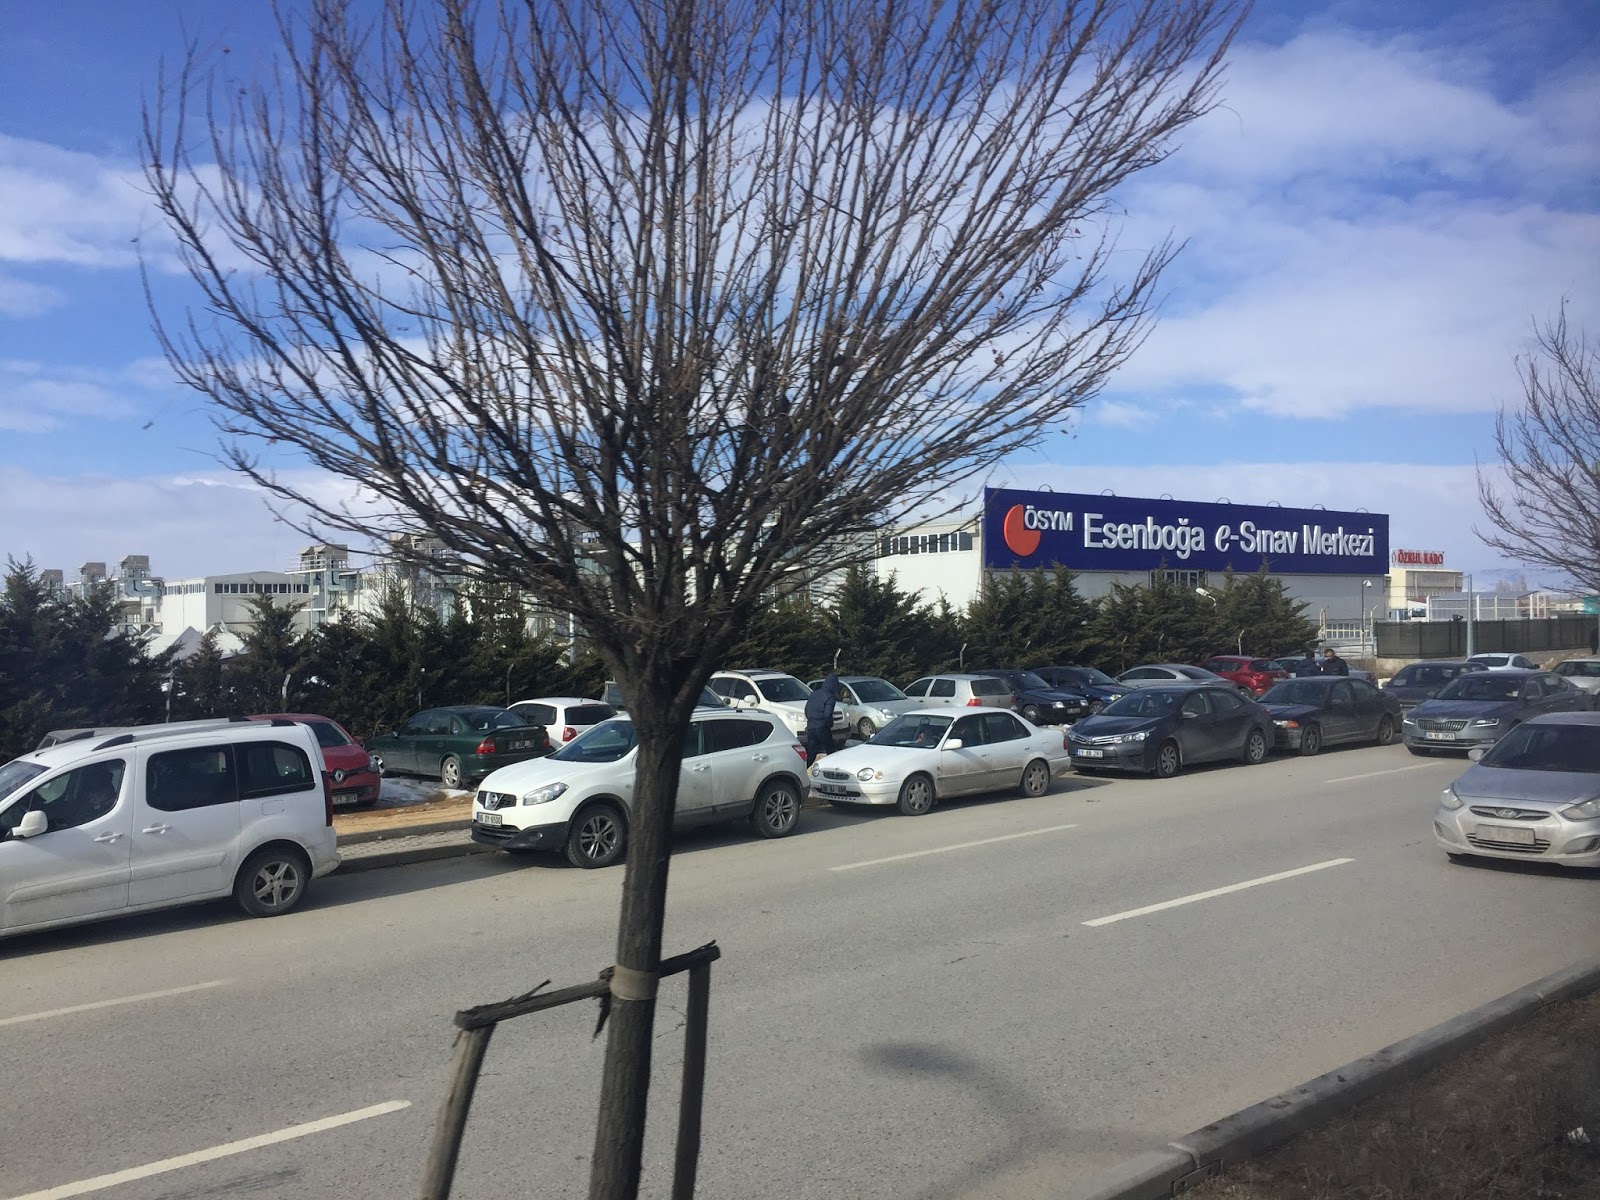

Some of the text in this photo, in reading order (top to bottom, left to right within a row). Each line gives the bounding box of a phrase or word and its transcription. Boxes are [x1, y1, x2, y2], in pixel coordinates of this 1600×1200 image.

[1024, 505, 1074, 531] ÖSYM
[1084, 512, 1375, 560] Esenboğa e-Sınav Merkezi
